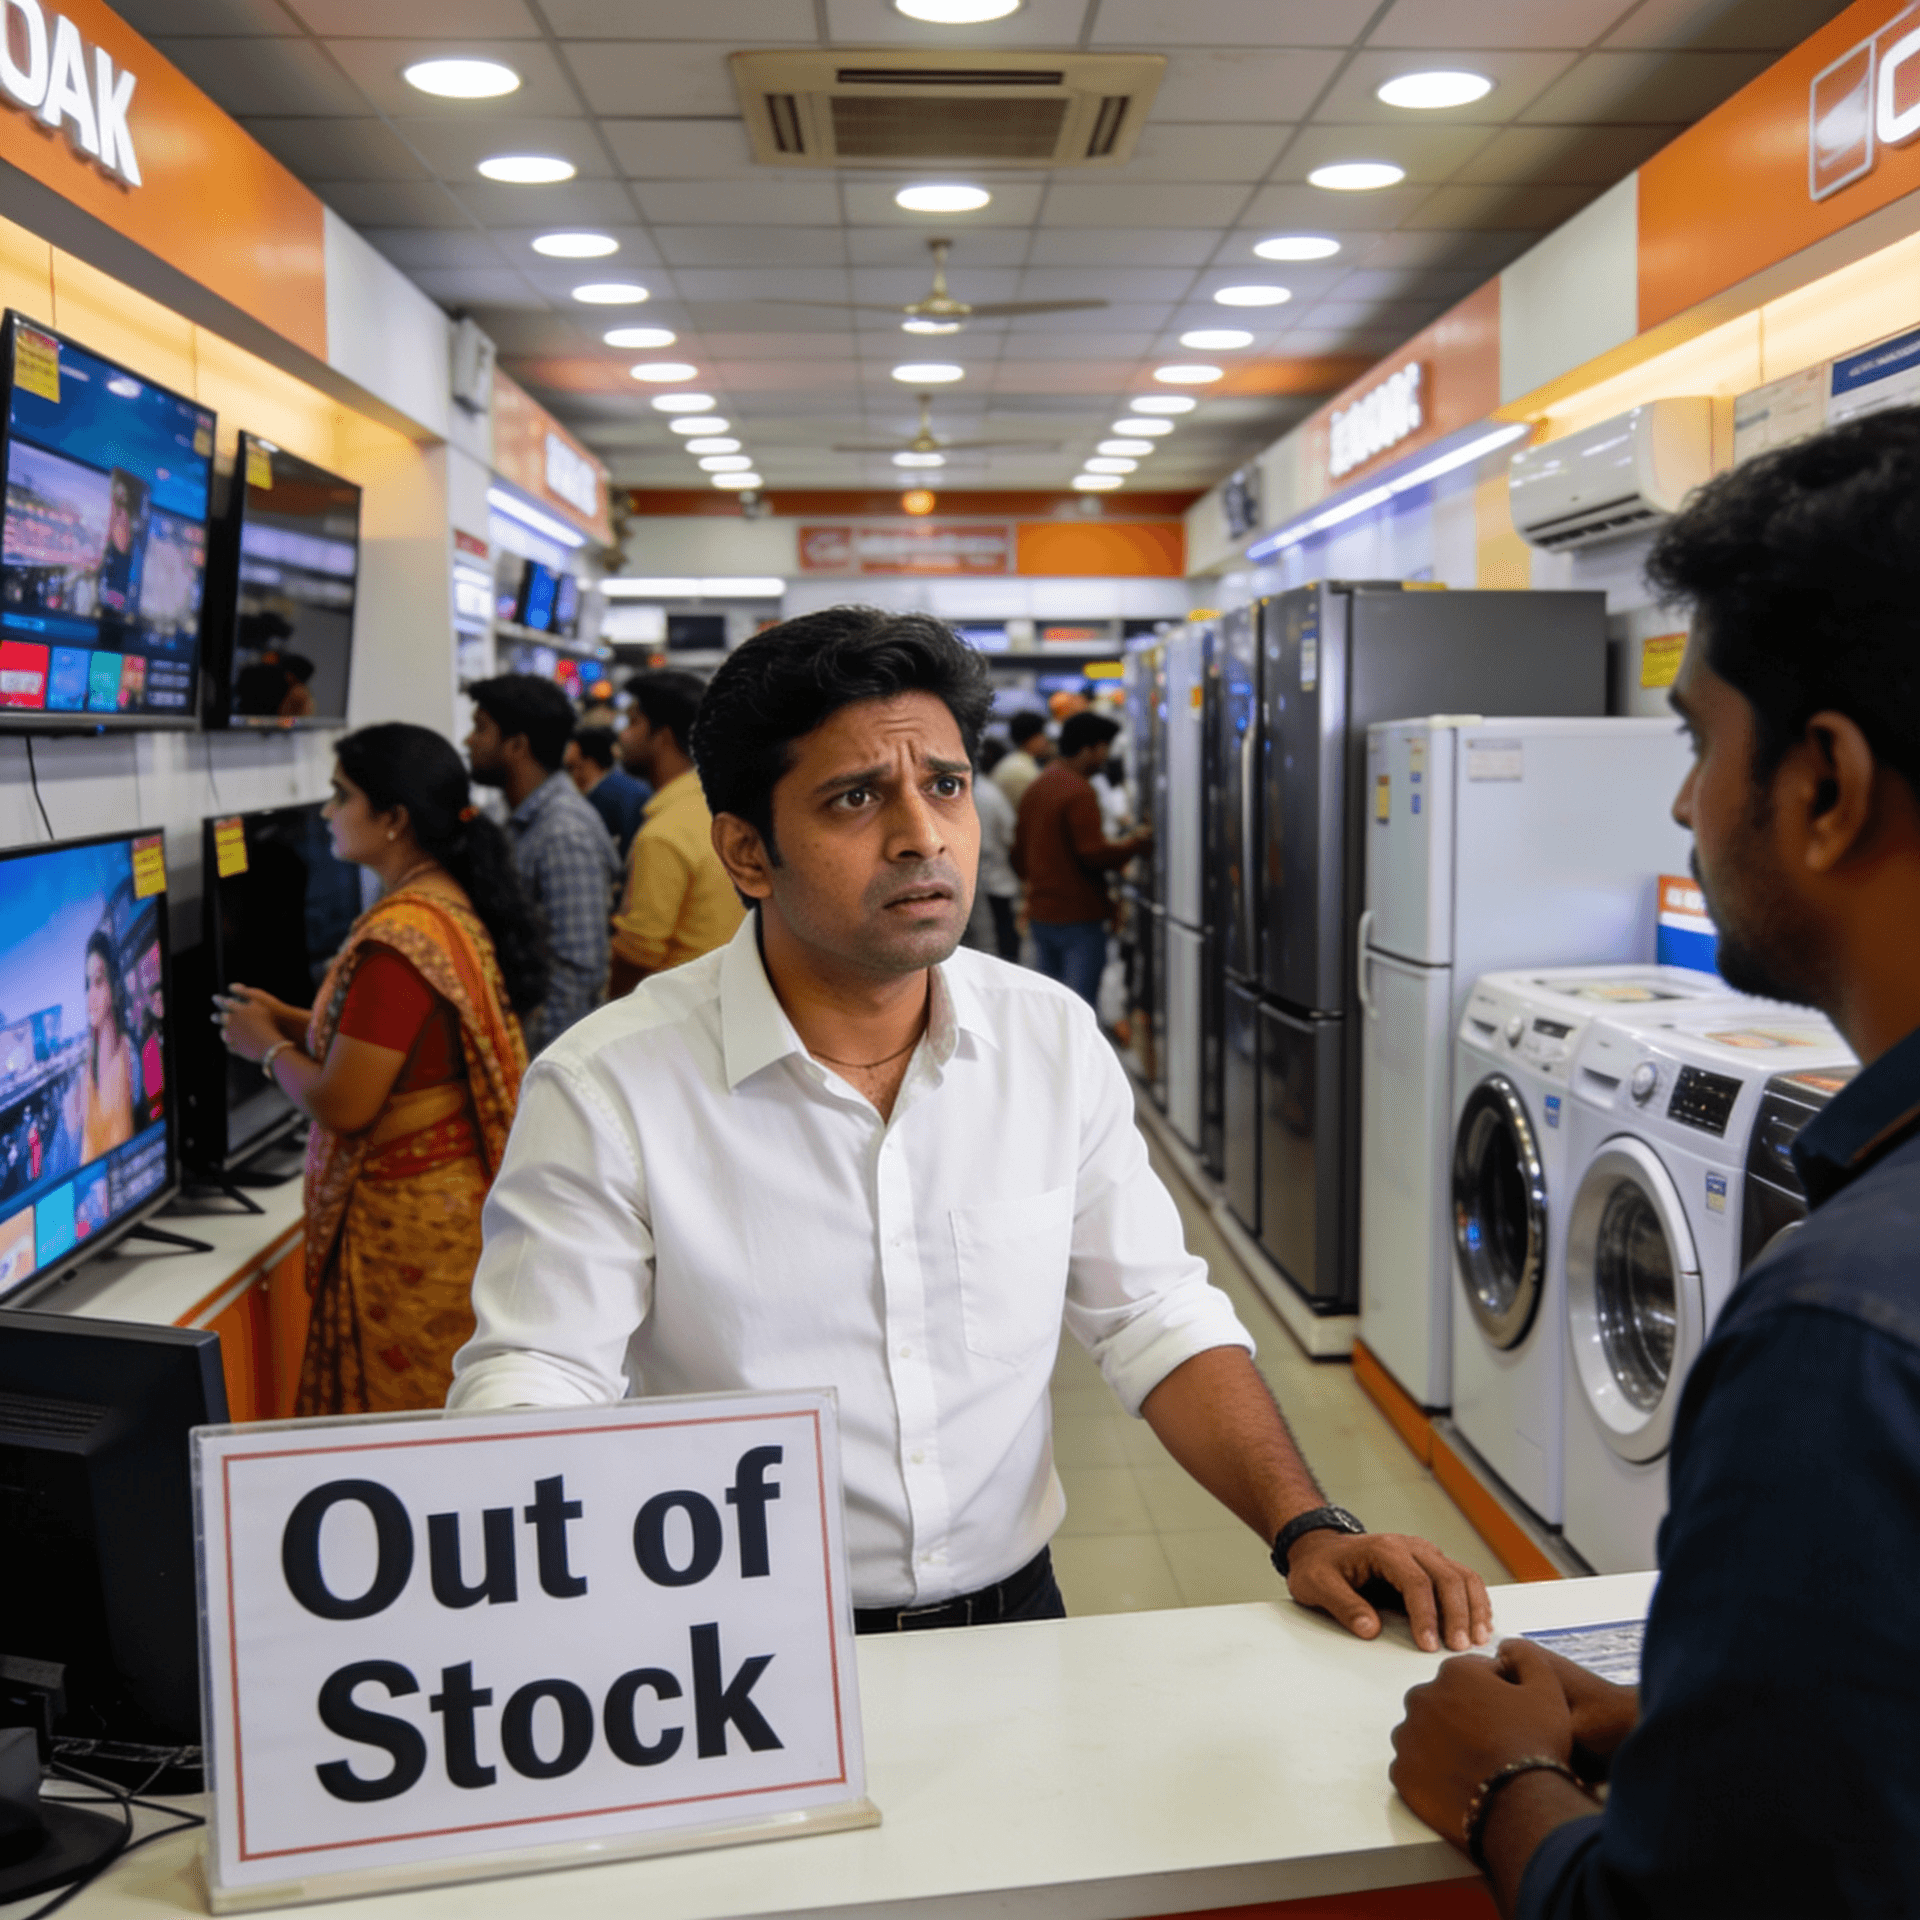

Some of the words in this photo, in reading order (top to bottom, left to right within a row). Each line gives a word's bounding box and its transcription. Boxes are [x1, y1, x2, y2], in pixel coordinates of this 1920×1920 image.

[281, 1475, 588, 1621] Out
[633, 1445, 784, 1588] of
[315, 1622, 785, 1803] Stock
